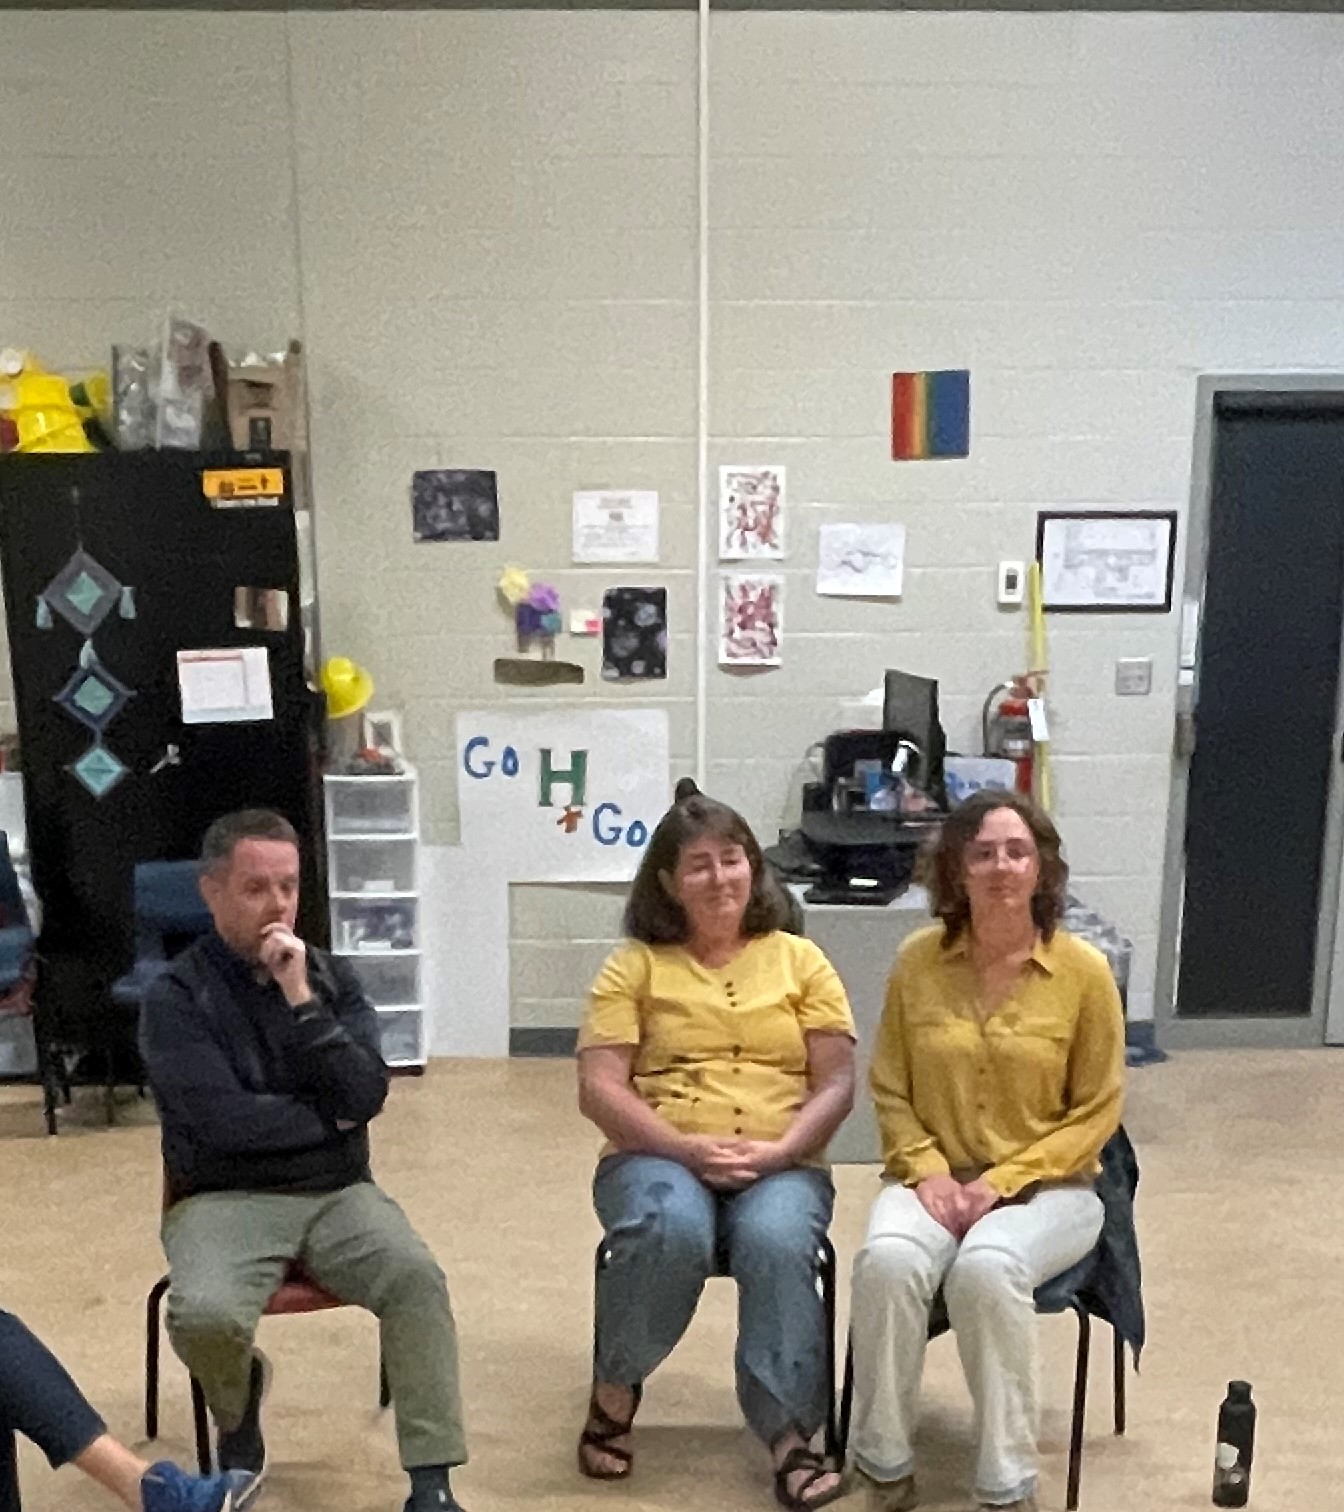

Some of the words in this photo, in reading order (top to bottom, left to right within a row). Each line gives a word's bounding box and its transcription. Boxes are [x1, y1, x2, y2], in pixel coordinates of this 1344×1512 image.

[464, 736, 519, 779] Go
[539, 748, 587, 807] H
[592, 802, 648, 847] Go
